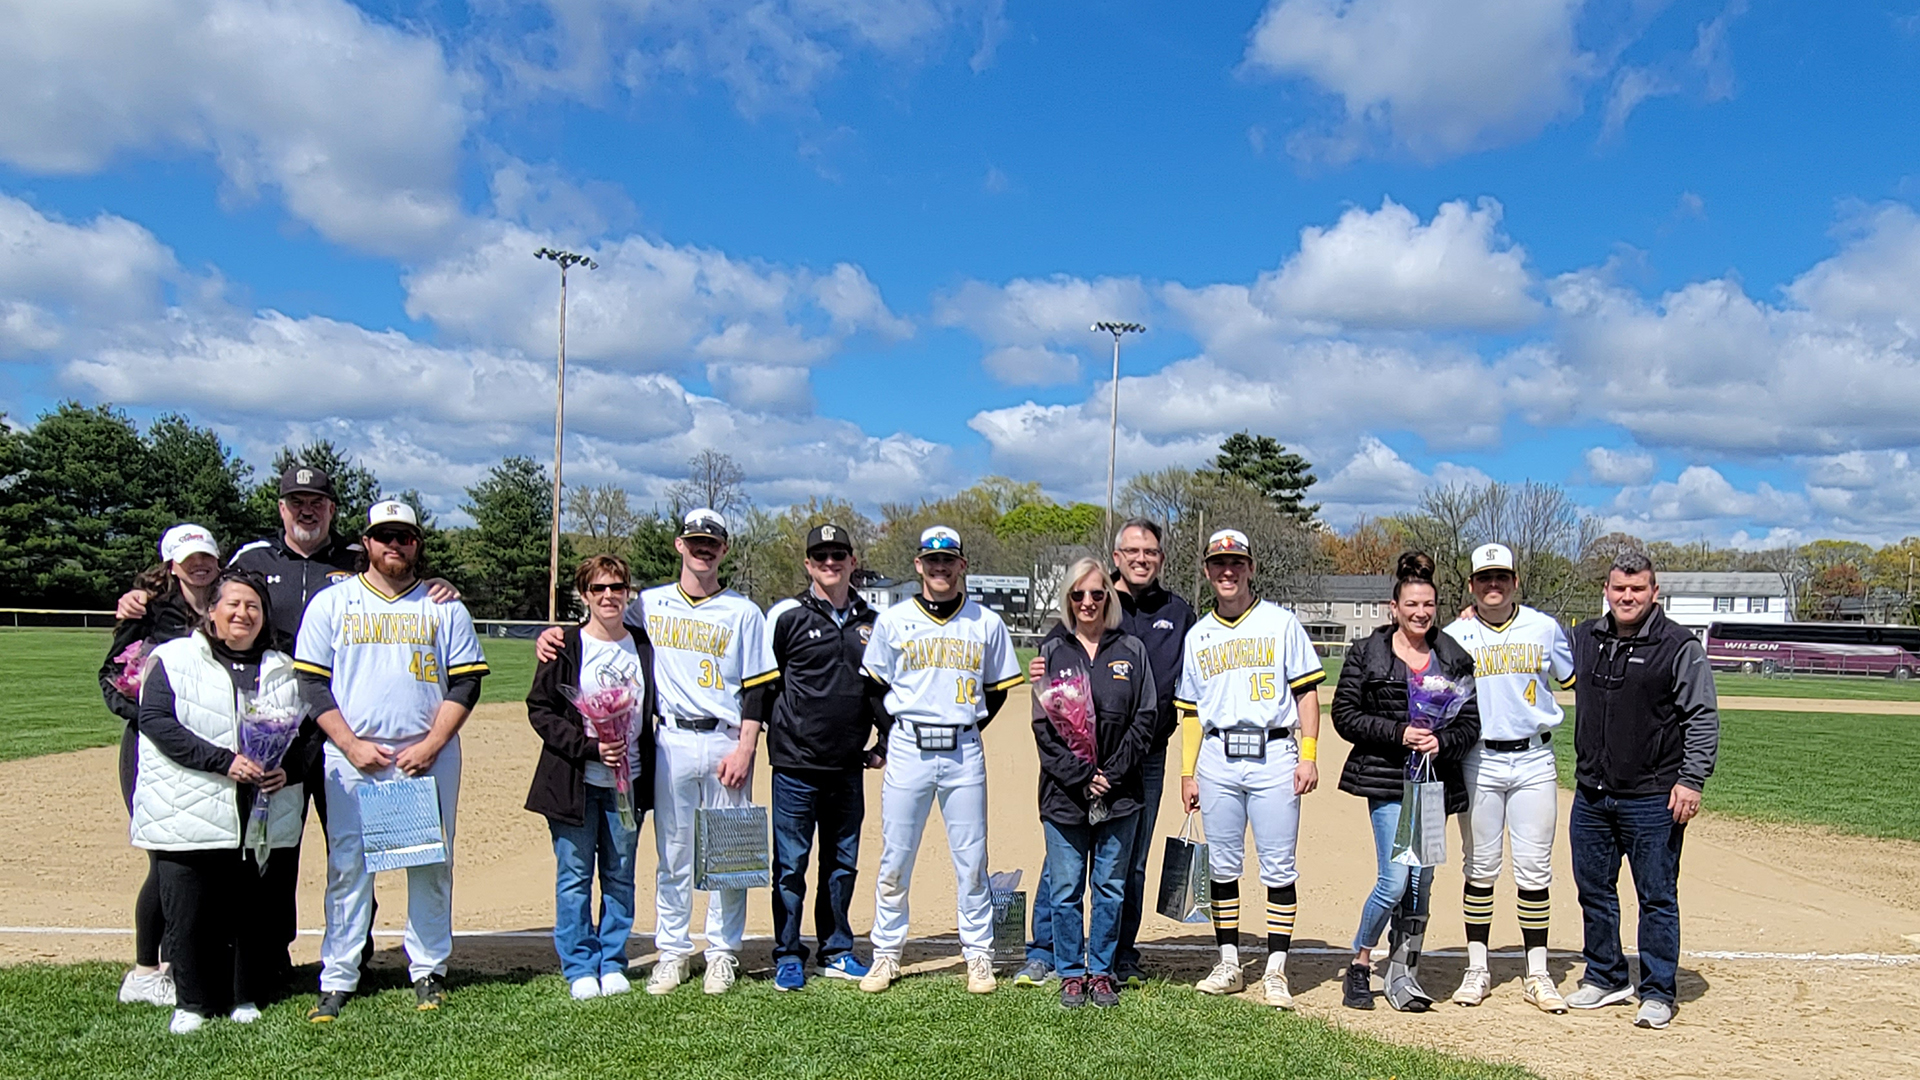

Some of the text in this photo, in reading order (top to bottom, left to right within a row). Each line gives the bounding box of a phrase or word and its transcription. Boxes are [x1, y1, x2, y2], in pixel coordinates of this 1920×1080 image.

[1196, 637, 1276, 681] FRAMINGHAM
[1467, 643, 1544, 678] AMINGHAM
[1724, 642, 1779, 651] WILSON
[409, 650, 440, 684] 42
[698, 659, 725, 691] 31
[956, 676, 978, 705] 10
[1249, 672, 1276, 701] 15
[1523, 679, 1538, 707] 4
